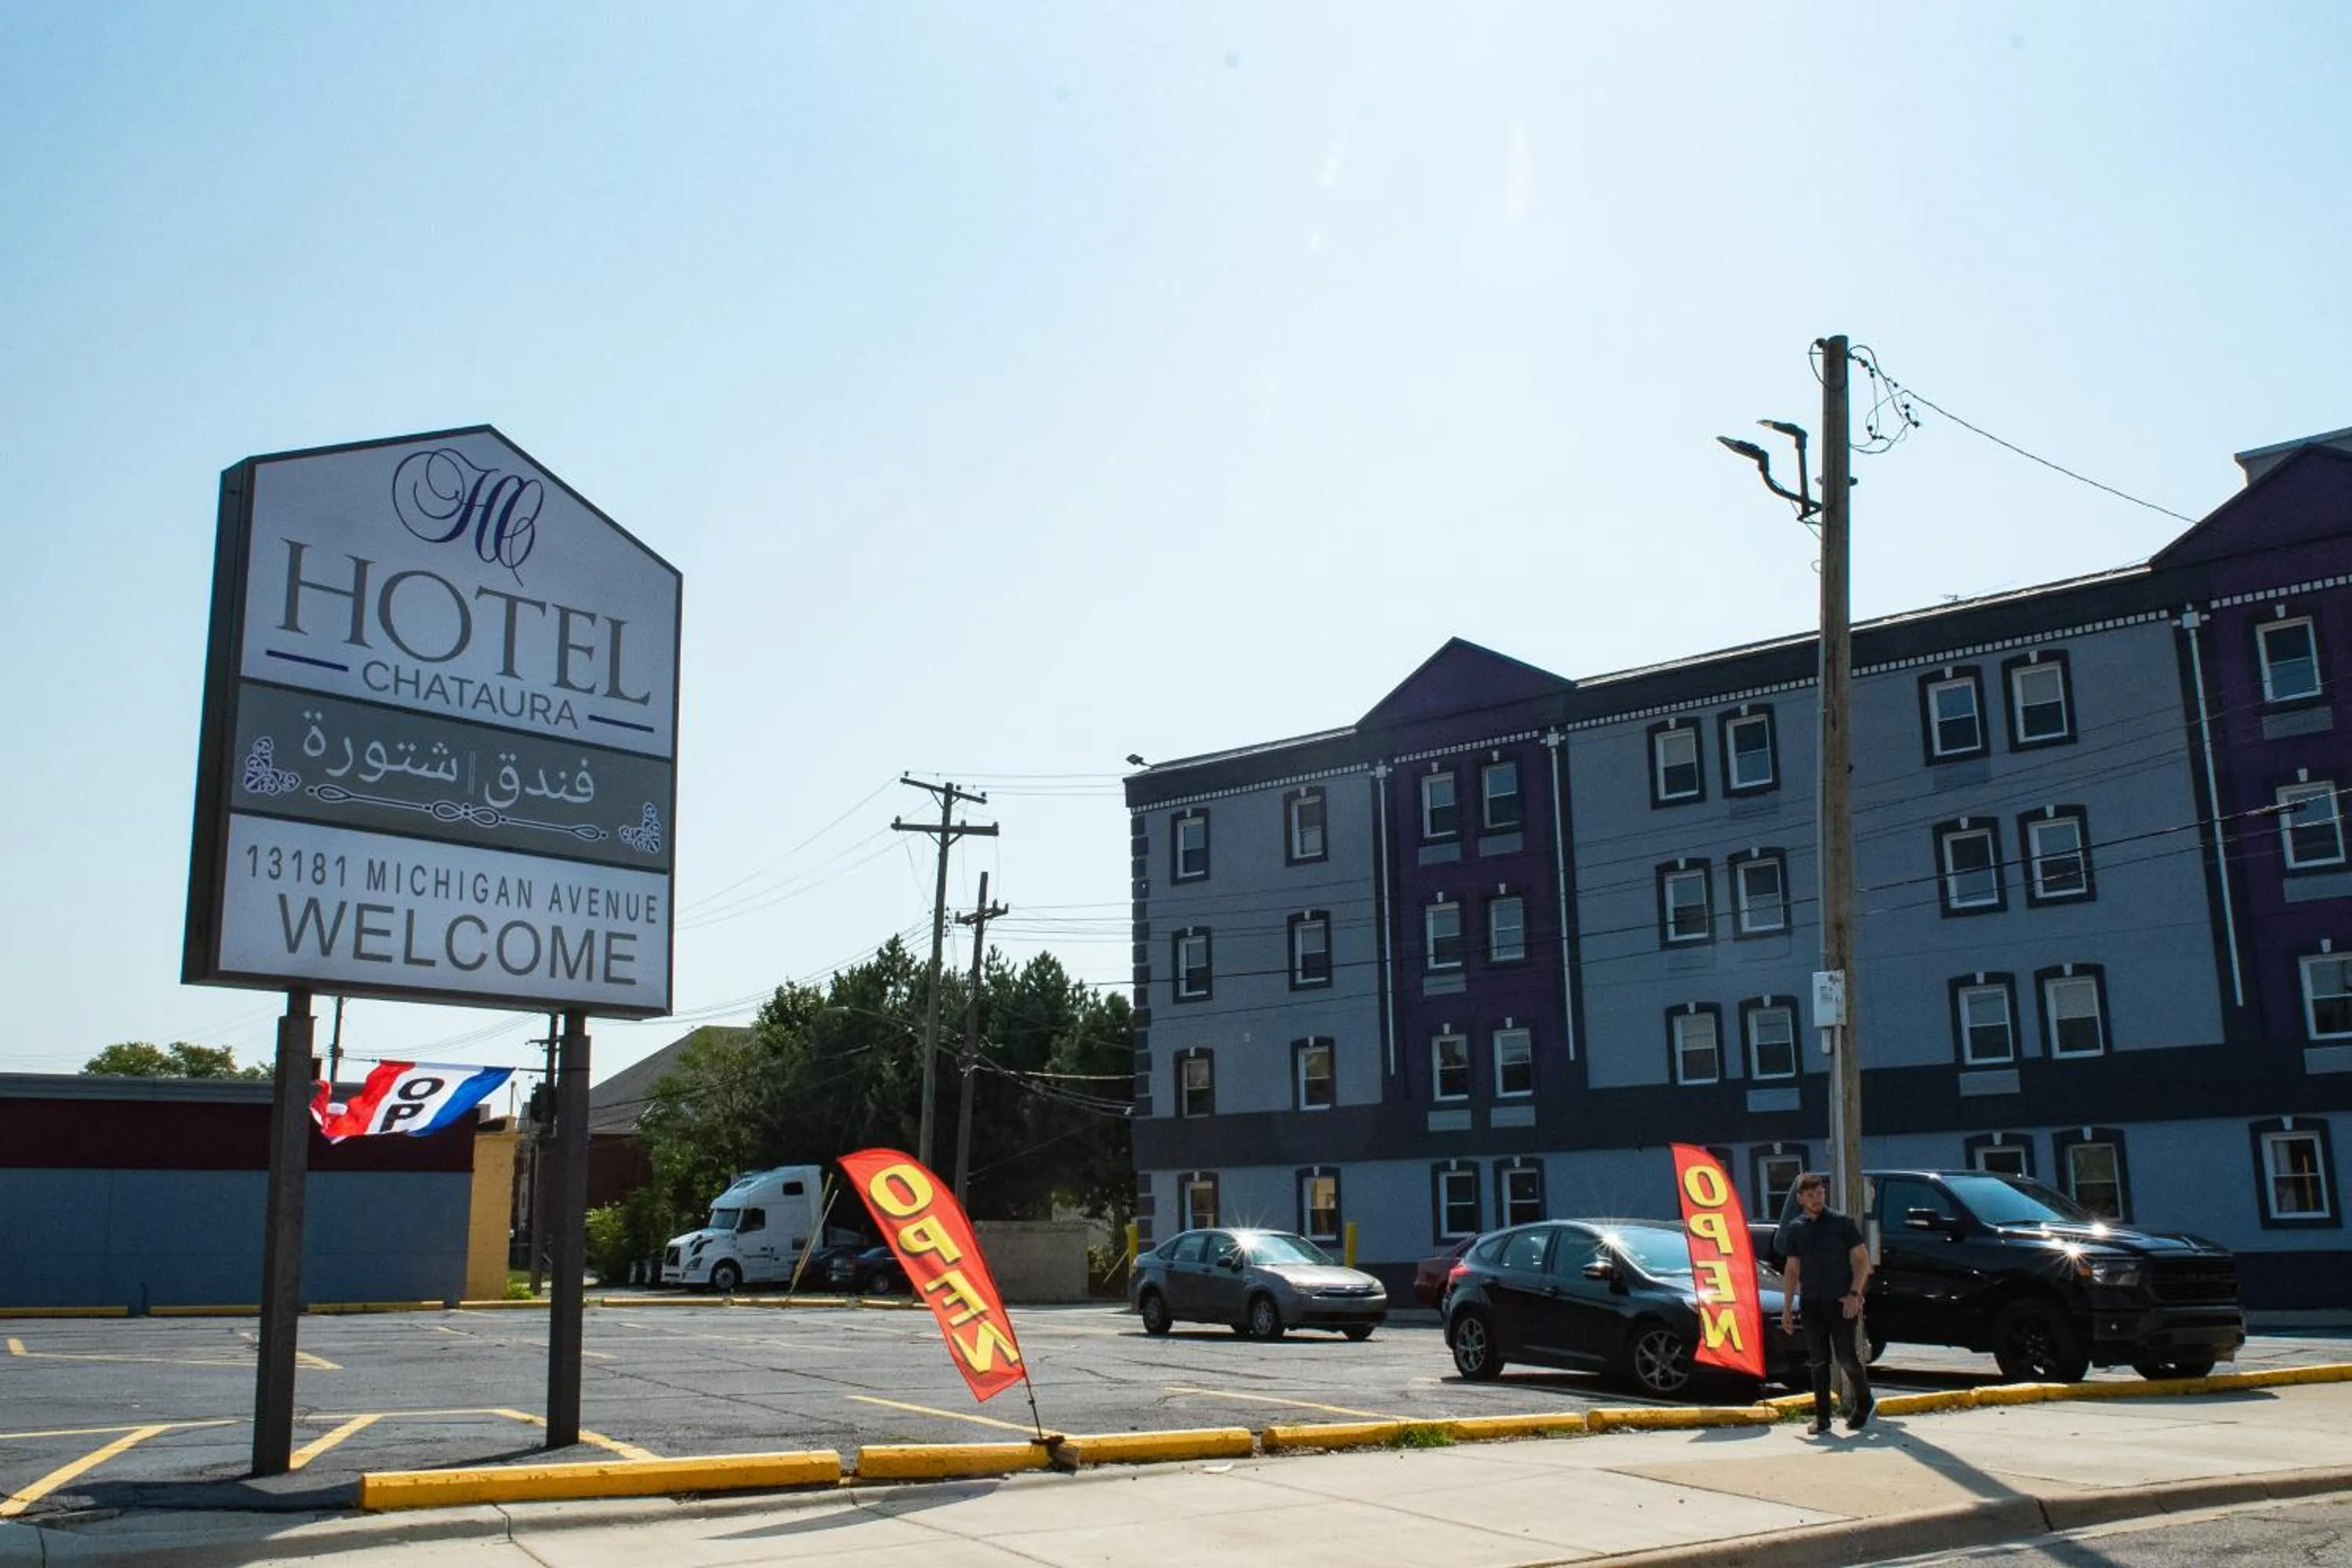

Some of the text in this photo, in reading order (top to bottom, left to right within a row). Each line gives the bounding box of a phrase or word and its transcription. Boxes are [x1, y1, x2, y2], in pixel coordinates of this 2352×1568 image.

[275, 537, 651, 706] HOTEL
[362, 660, 578, 729] CHATAURA
[303, 710, 596, 808] فندق شتورة
[246, 844, 659, 924] 13181 MICHIGAN AVENUE
[278, 893, 637, 985] WELCOME
